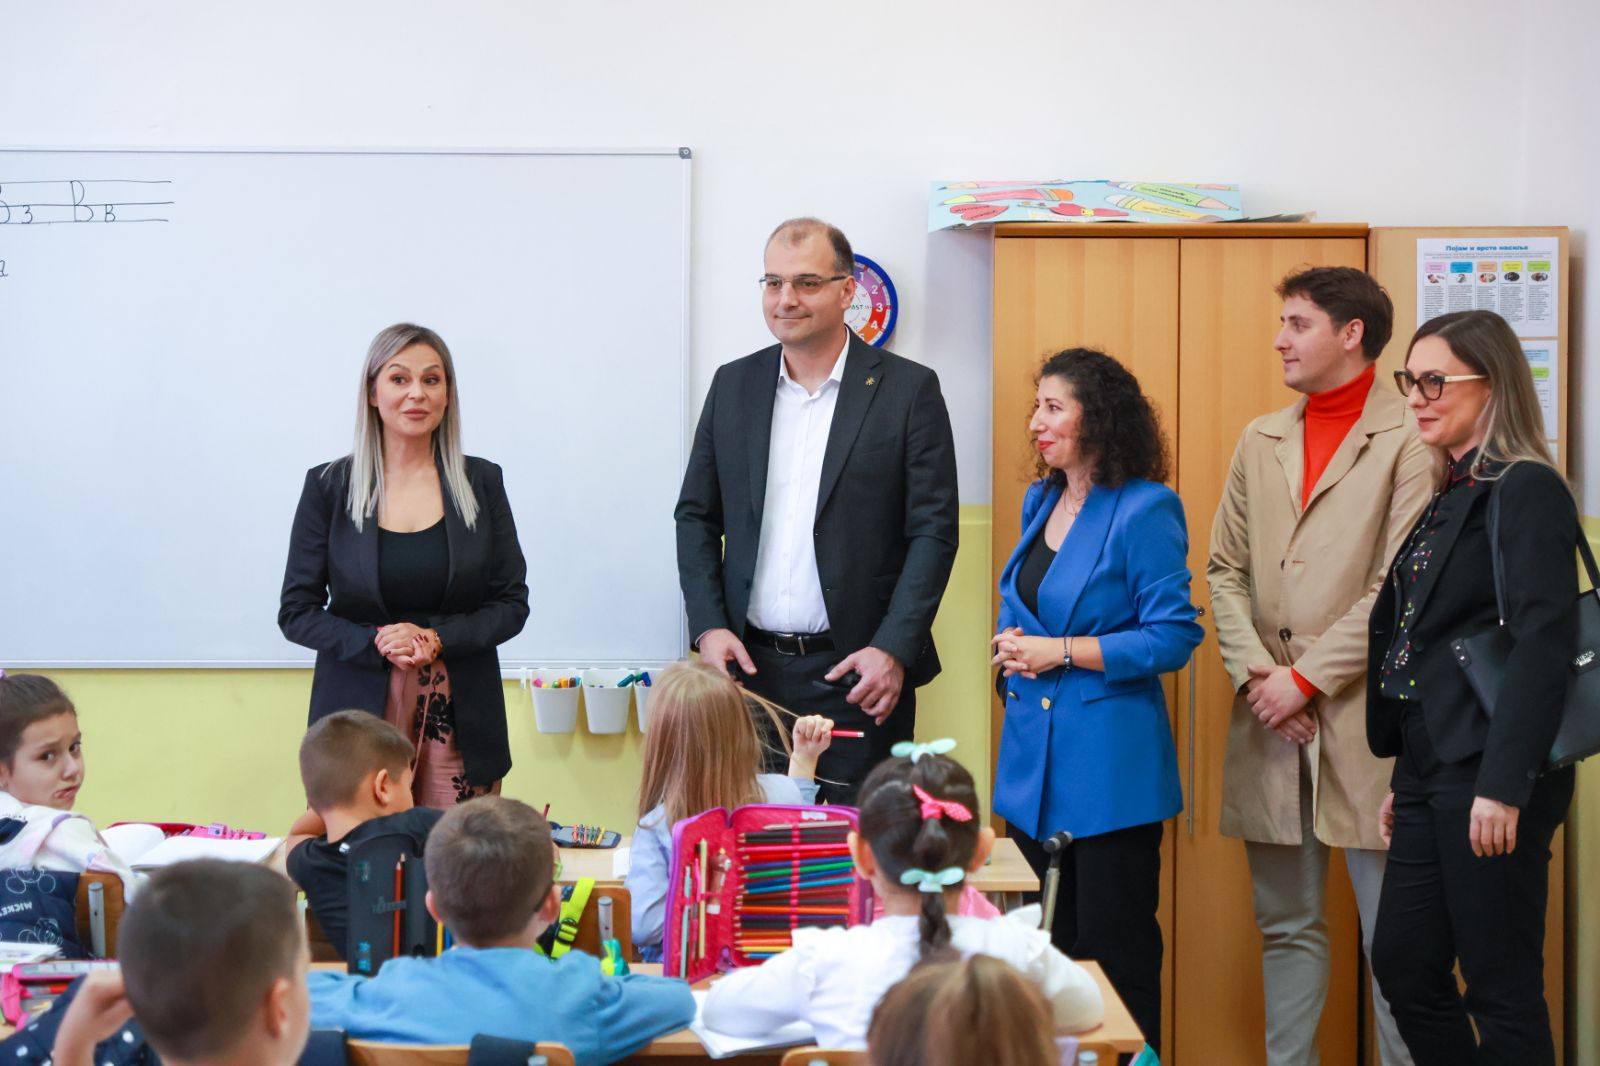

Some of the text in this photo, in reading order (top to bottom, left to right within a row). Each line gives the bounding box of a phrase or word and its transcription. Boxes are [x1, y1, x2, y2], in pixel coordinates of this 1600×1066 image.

[859, 272, 864, 282] 1
[871, 285, 879, 295] 2
[876, 303, 884, 313] 3
[871, 320, 878, 329] 4
[0, 901, 32, 917] MICKE
